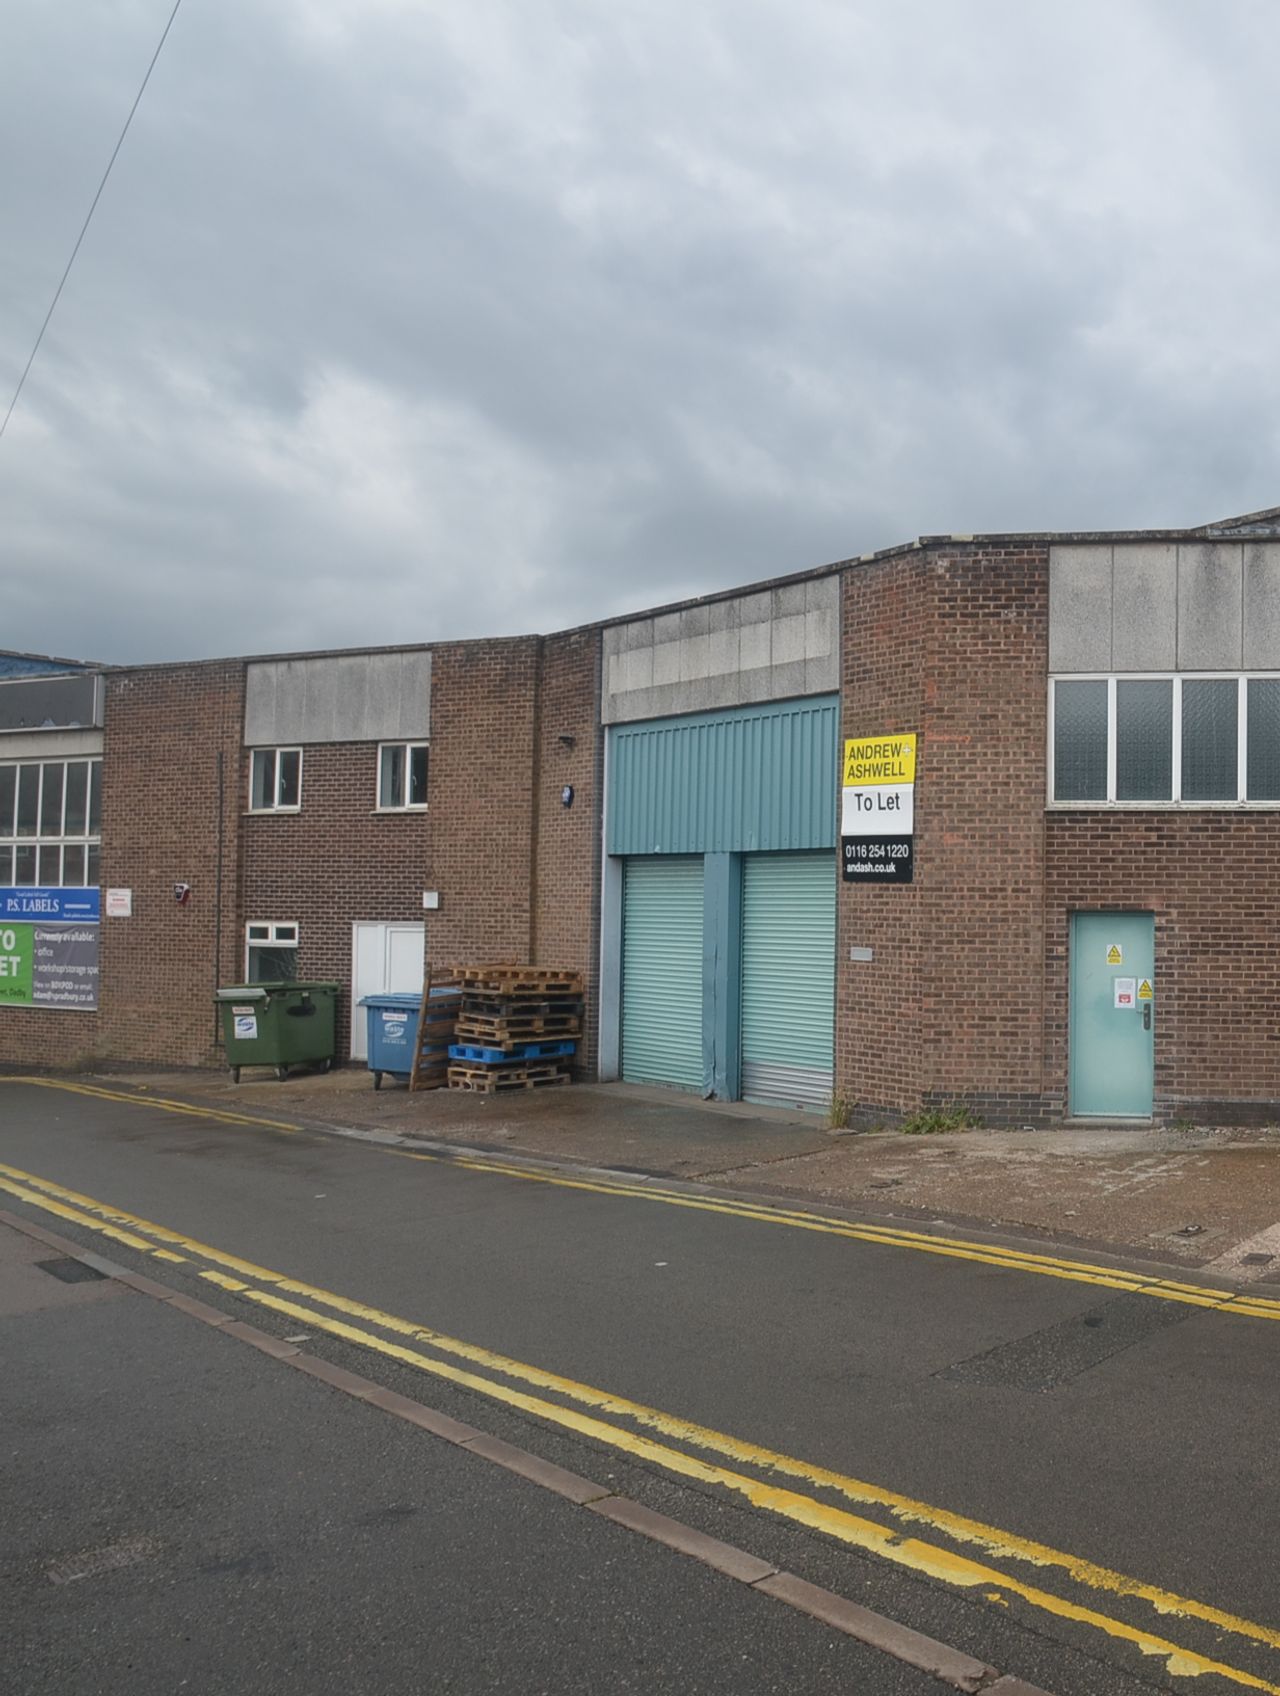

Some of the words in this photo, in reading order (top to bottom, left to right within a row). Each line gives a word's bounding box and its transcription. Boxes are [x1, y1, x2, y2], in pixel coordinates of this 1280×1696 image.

[848, 743, 902, 761] ANDREW
[847, 761, 906, 779] ASHWELL
[854, 793, 873, 811] To
[877, 792, 900, 811] Let
[845, 845, 867, 858] 0116
[868, 844, 885, 858] 254
[886, 844, 909, 858] 1220
[846, 862, 896, 873] andash.co.uk
[22, 898, 59, 913] LABELS
[0, 929, 16, 951] O
[0, 955, 21, 977] ET
